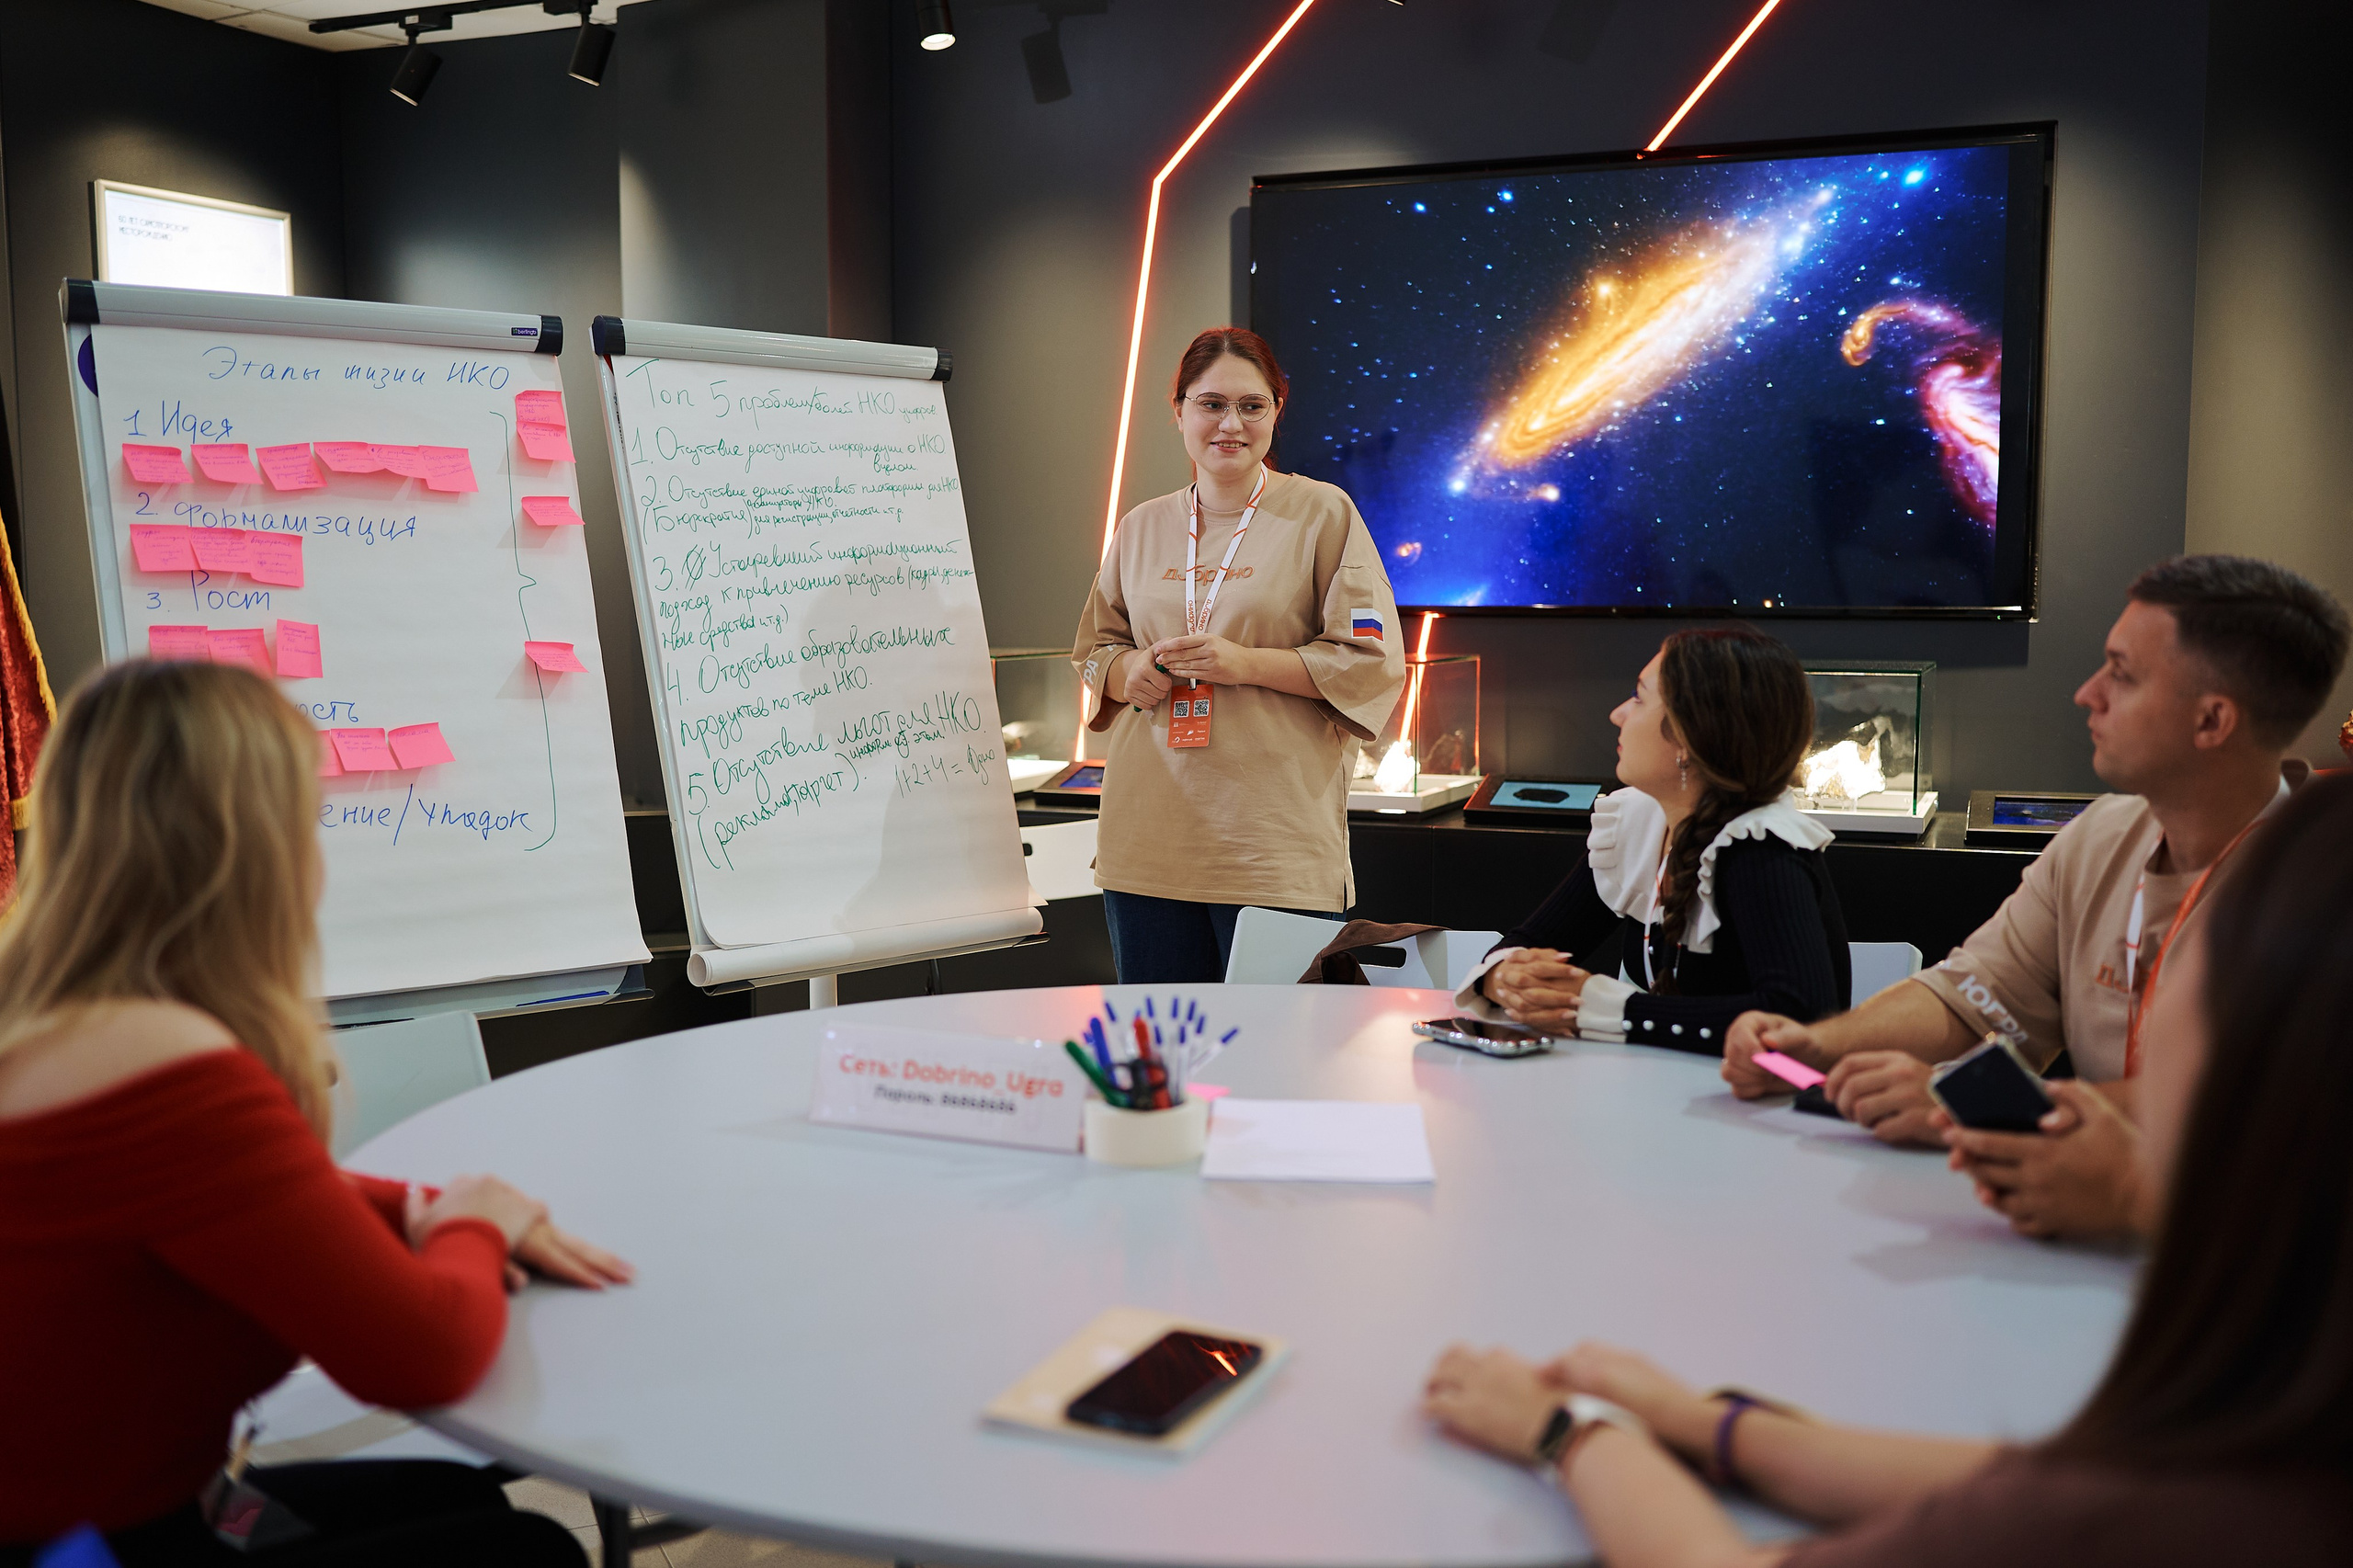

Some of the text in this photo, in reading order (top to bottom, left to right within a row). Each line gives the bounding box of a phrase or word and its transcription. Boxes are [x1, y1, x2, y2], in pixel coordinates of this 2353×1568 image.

[517, 328, 537, 336] berlingo
[201, 346, 321, 381] Этапы
[626, 358, 696, 408] Топ
[709, 380, 731, 418] 5
[857, 391, 895, 415] НКО
[162, 400, 233, 444] Идея
[655, 426, 744, 465] Отсутствие
[746, 439, 826, 472] доступной
[828, 440, 904, 461] информации
[907, 444, 916, 453] о
[668, 475, 748, 509] Отсутствие
[190, 569, 269, 612] Рост
[659, 595, 713, 635] подход
[845, 565, 905, 597] ресурсов
[699, 613, 756, 653] средства
[699, 642, 798, 694] Отсутствие
[712, 726, 830, 805] Отсутствие
